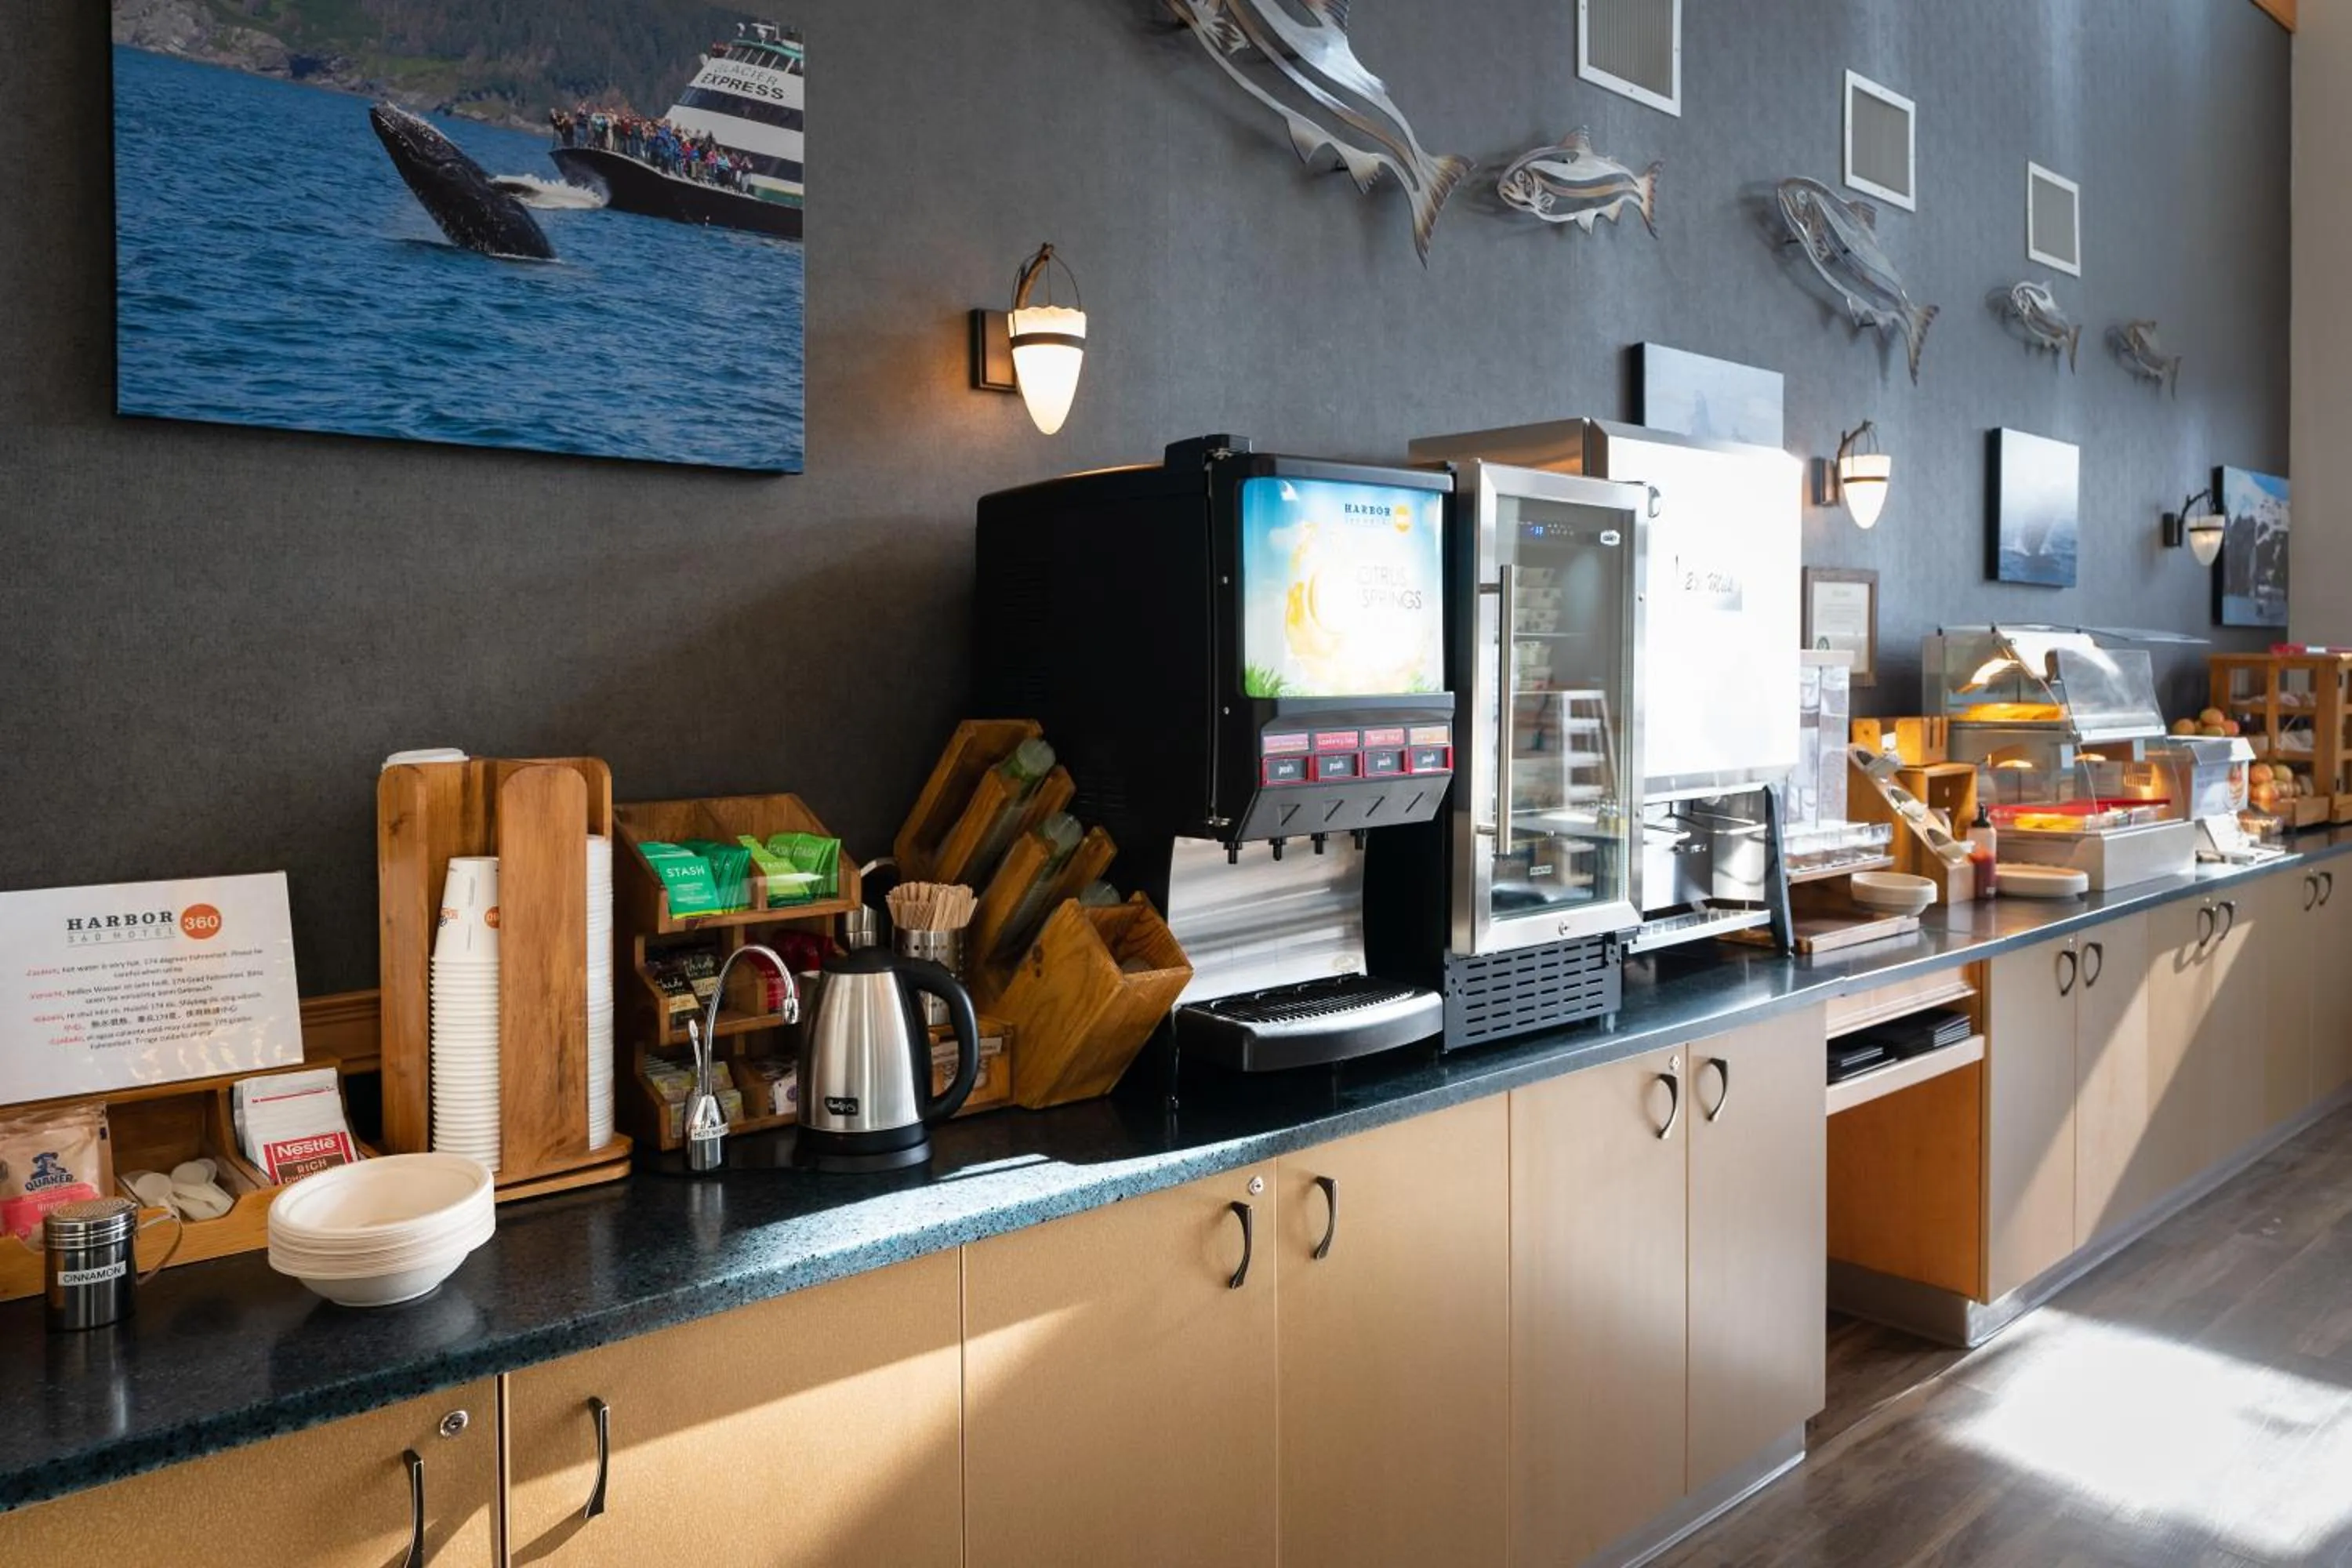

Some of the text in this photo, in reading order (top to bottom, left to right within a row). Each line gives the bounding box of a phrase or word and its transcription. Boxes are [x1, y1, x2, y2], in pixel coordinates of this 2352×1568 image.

[701, 73, 784, 100] EXPRESS
[1345, 503, 1391, 517] HARBOR
[666, 865, 705, 878] STASH
[67, 910, 174, 931] HARBOR
[184, 915, 220, 931] 360
[297, 1158, 328, 1174] RICH
[25, 1174, 74, 1192] QUAKER
[63, 1265, 122, 1283] CINNAMON
